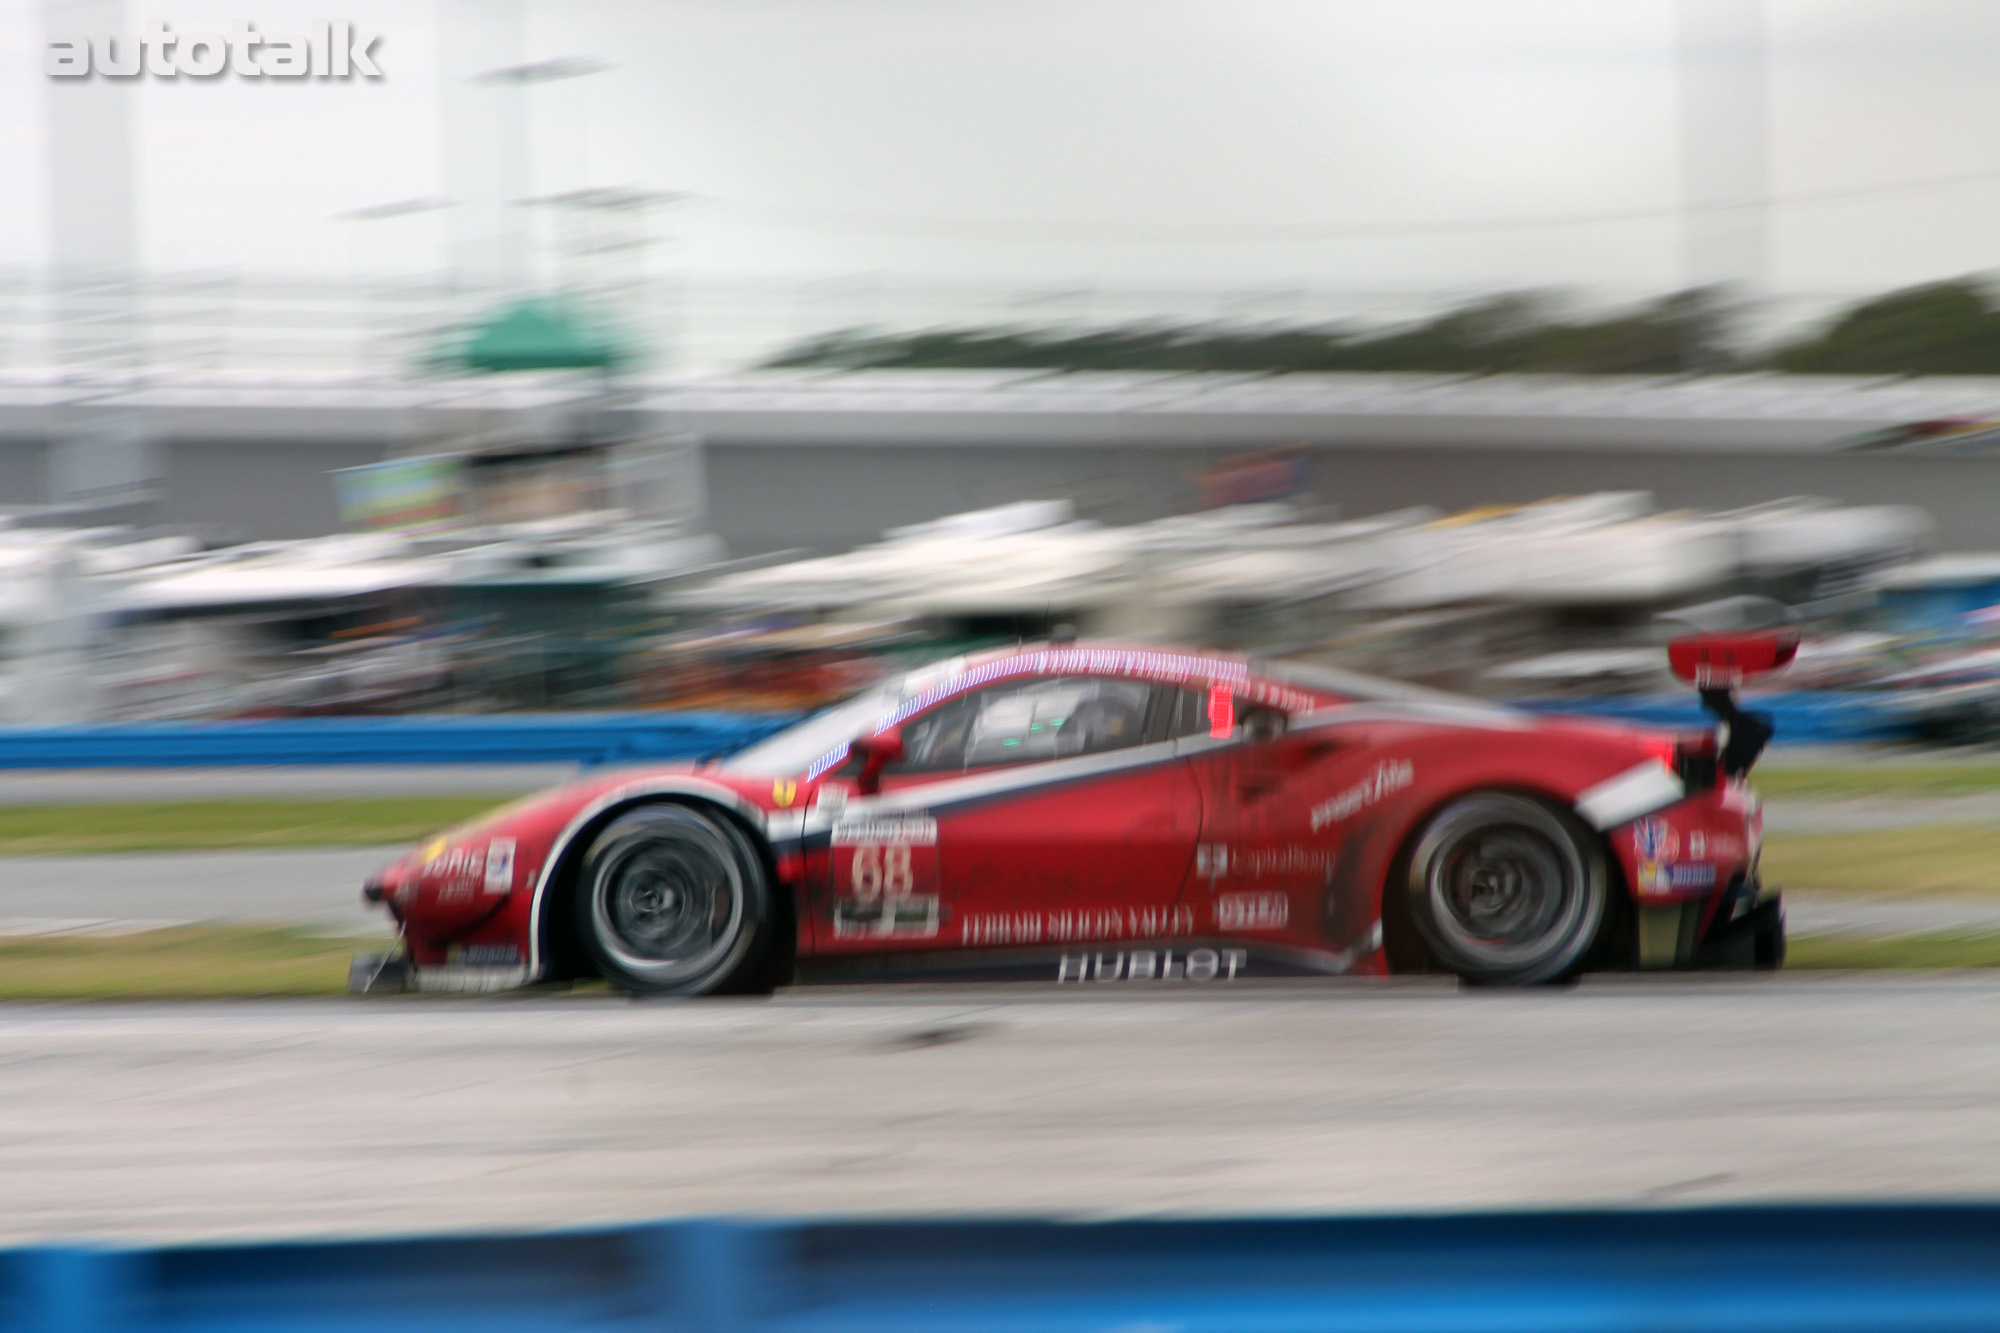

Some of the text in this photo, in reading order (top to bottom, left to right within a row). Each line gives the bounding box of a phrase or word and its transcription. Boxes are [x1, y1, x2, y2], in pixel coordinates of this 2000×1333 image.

[851, 840, 914, 903] 68
[962, 911, 1042, 946] FERRARI
[1048, 908, 1123, 941] SILICON
[1129, 905, 1193, 938] VALLEY
[1057, 948, 1247, 984] HUBLOT
